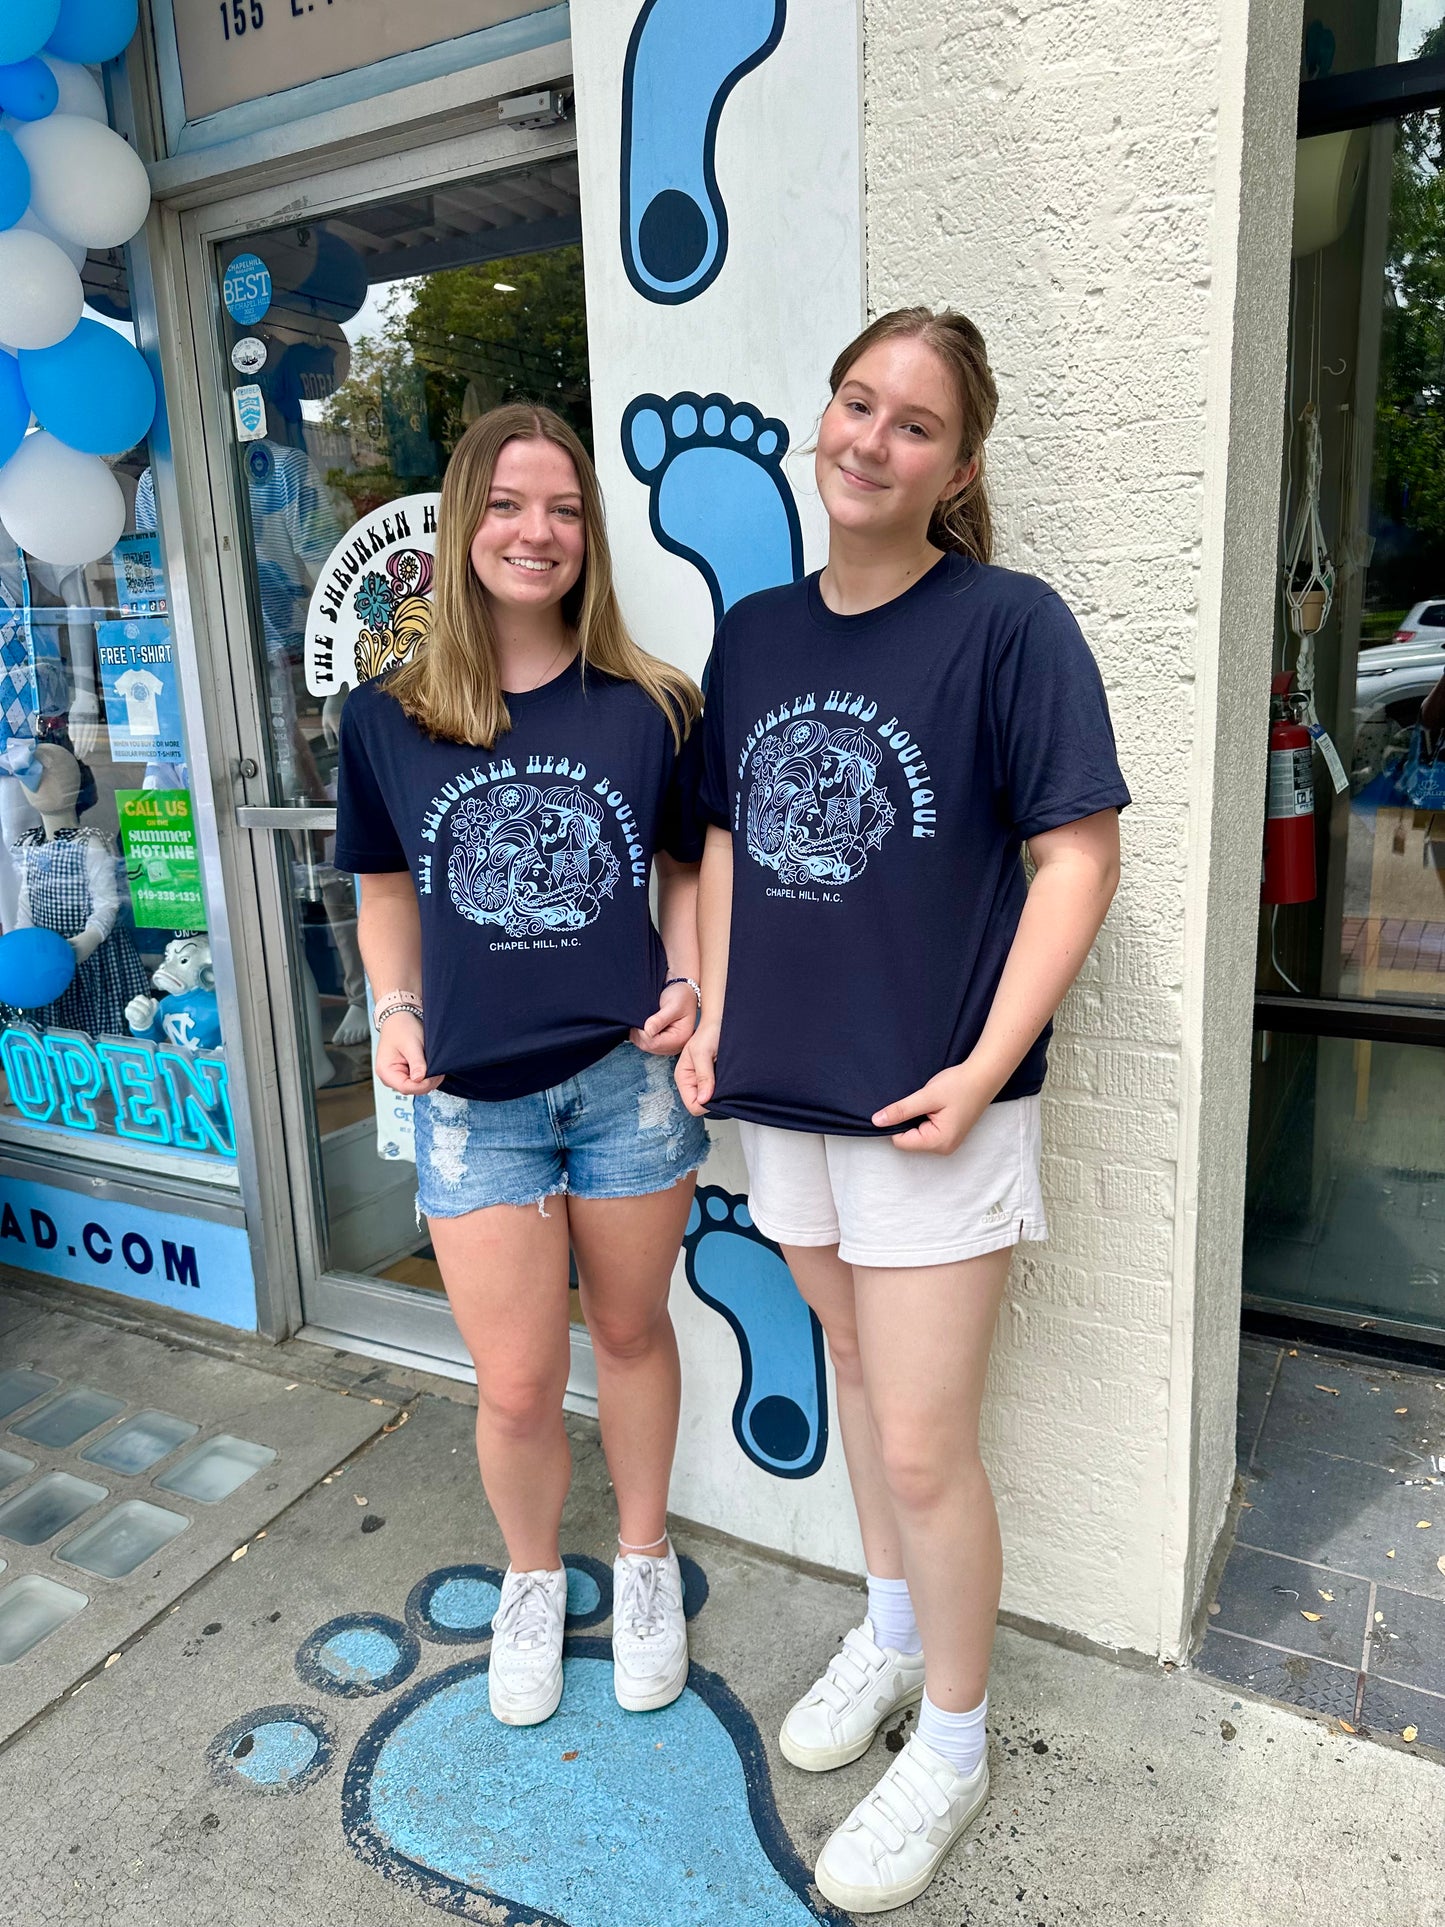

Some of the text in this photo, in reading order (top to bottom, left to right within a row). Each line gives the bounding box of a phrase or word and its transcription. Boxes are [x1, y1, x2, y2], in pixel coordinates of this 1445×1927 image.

[220, 0, 264, 40] 155
[223, 271, 270, 305] BEST
[234, 299, 257, 311] CHAPEL
[319, 510, 411, 624] SHRUNKEN
[99, 644, 172, 665] FREE T-SHIRT
[313, 634, 334, 685] THE
[165, 740, 180, 748] MORE
[737, 692, 816, 779] SHRUNKEN
[822, 690, 879, 723] HEAD
[877, 716, 937, 839] BOUTIQUE
[124, 800, 188, 817] CALL US
[146, 819, 156, 827] ON
[421, 758, 518, 845] SHRUNKEN
[525, 755, 587, 782] HEAD
[593, 776, 646, 888] BOUTIQUE
[128, 829, 192, 843] summer
[130, 844, 195, 860] HOTLINE
[137, 889, 201, 902] 919-338-1331
[766, 887, 844, 903] CHAPEL HILL, N.C.
[489, 938, 582, 952] CHAPEL HILL, N.C.
[0, 1028, 237, 1157] OPEN
[0, 1202, 201, 1290] AD.COM
